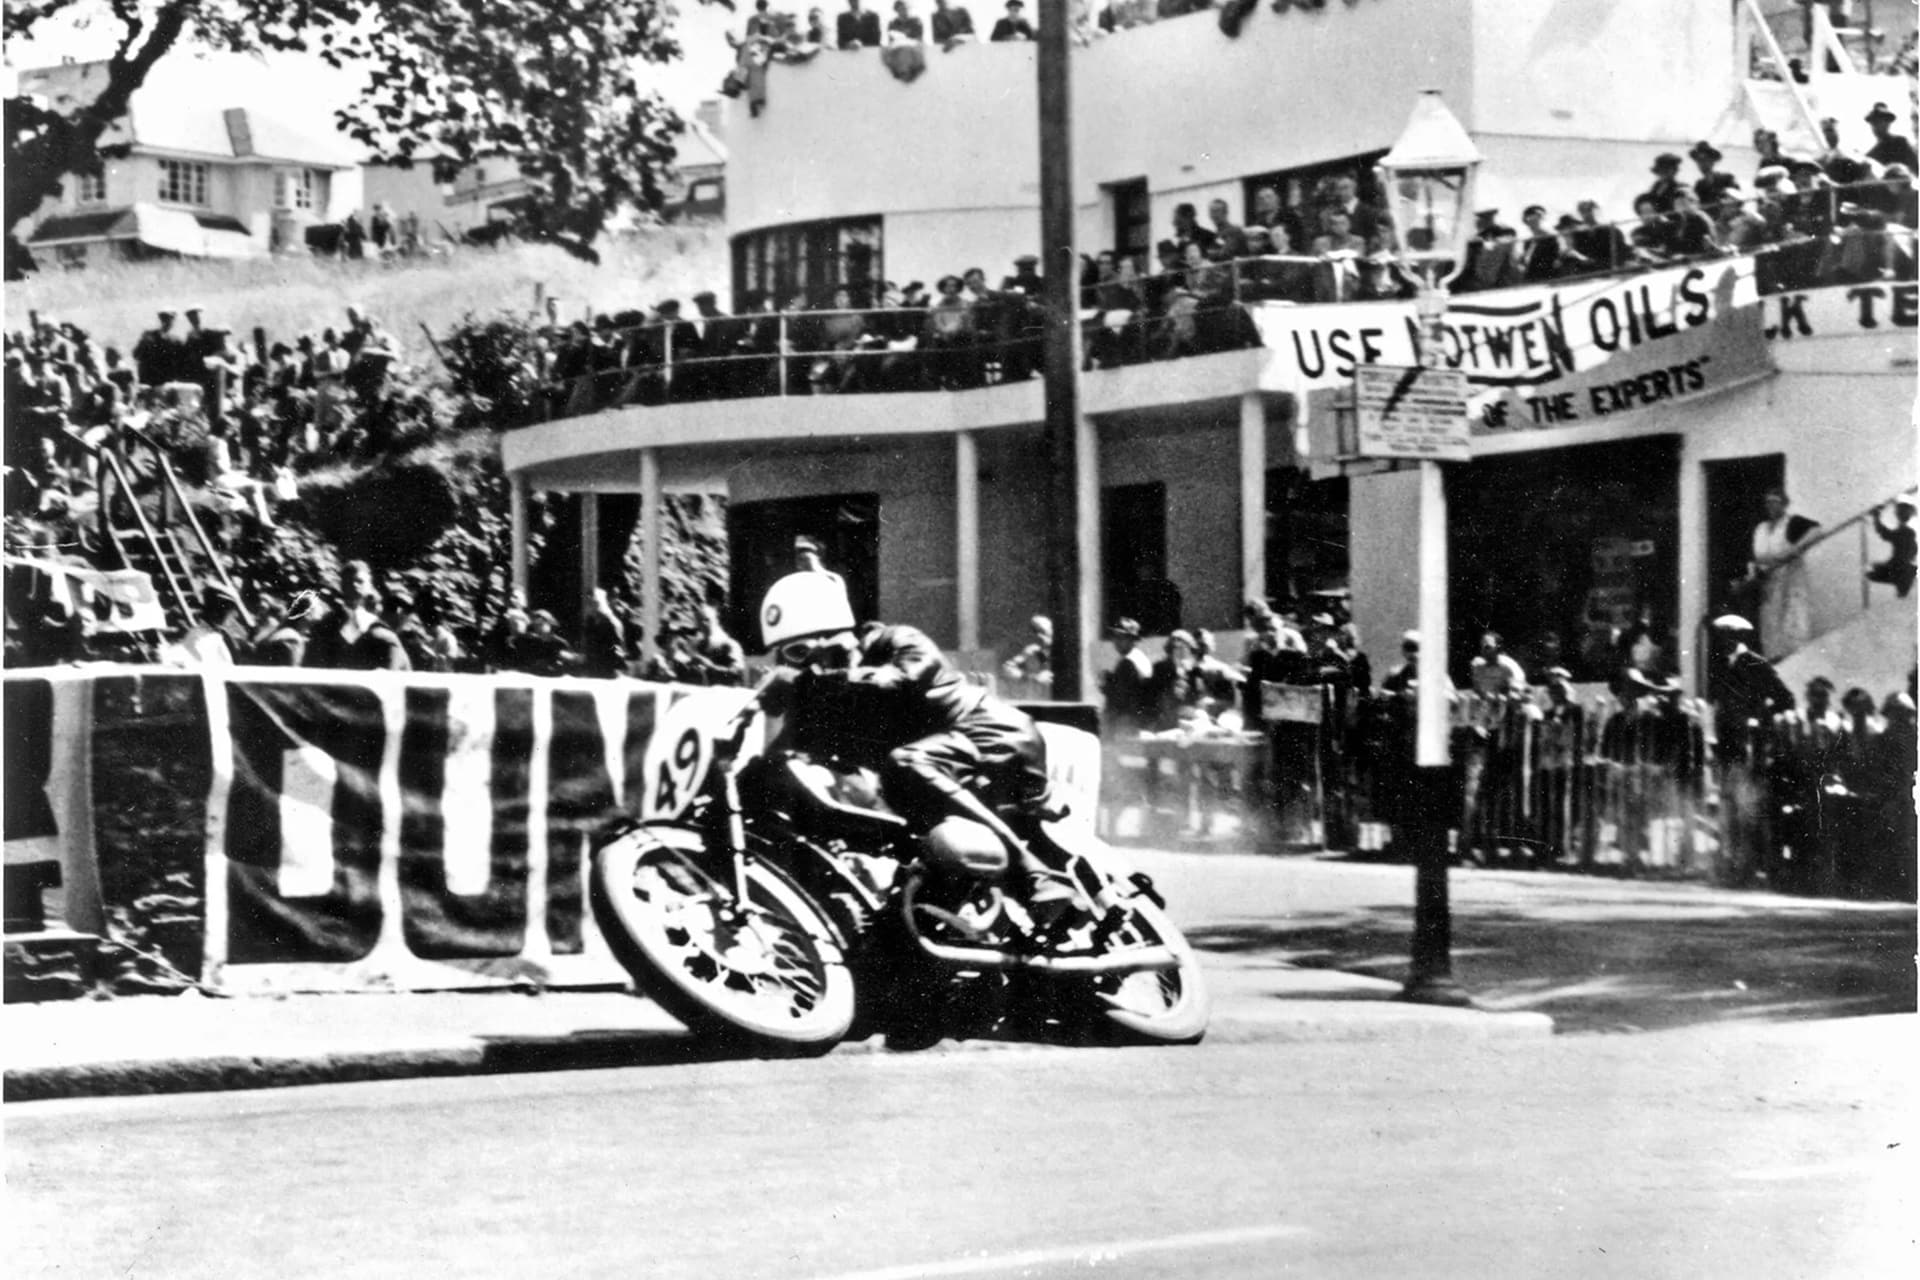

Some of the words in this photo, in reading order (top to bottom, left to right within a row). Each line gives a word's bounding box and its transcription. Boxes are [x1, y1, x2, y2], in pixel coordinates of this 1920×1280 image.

[1291, 328, 1384, 379] USE
[1590, 269, 1708, 351] OILS
[1525, 392, 1579, 424] THE
[655, 727, 701, 812] 49
[227, 680, 690, 962] DUN
